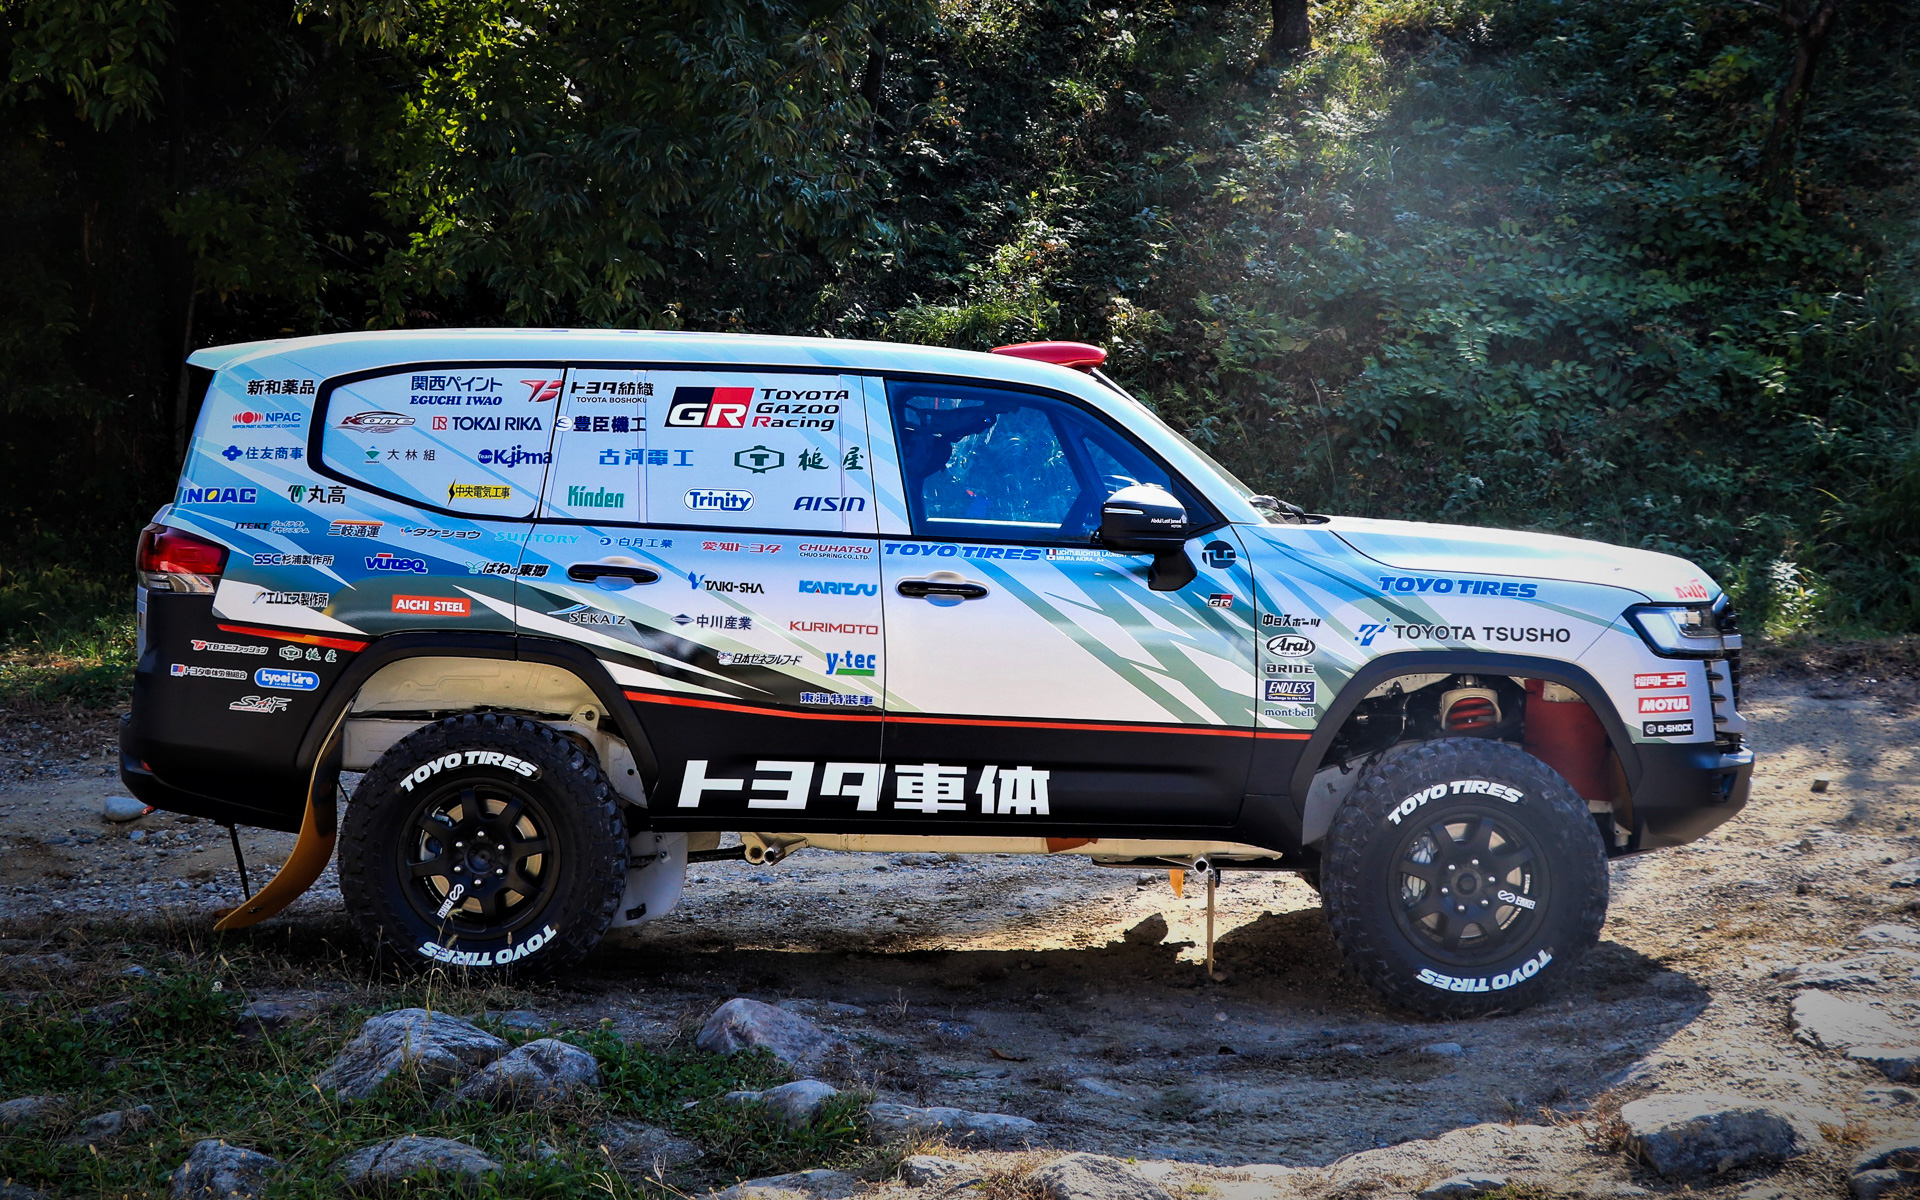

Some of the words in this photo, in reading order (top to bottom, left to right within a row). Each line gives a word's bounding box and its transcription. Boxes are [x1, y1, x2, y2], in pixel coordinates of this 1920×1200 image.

[247, 379, 316, 396] 新和薬品
[411, 376, 503, 392] 関西ペイント
[571, 381, 654, 396] トヨタ紡織
[410, 395, 461, 406] EGUCHI
[466, 396, 502, 406] IWAO
[760, 388, 849, 400] TOYOTA
[668, 403, 747, 427] GR
[755, 403, 839, 414] GAZOO
[265, 412, 302, 422] NPAC
[452, 416, 500, 431] TOKAI
[505, 416, 542, 431] RIKA
[573, 415, 647, 433] 豊臣機工
[752, 416, 835, 432] Racing
[246, 447, 304, 460] 住友商事
[387, 449, 436, 461] 大林組
[599, 448, 694, 467] 古河電工
[308, 485, 347, 504] 丸高
[455, 485, 511, 499] 中央電気工事
[568, 486, 624, 508] Kinden
[689, 491, 752, 511] Trinity
[793, 496, 865, 511] AISIN
[233, 522, 270, 530] JTEKT
[328, 524, 381, 538] 三岐通運
[413, 527, 481, 539] タケショウ
[618, 537, 673, 549] 白月工業
[702, 541, 782, 553] 愛知トヨタ
[798, 543, 873, 554] CHUHATSU
[884, 543, 960, 558] TOYO
[961, 547, 1041, 561] TIRES
[254, 555, 281, 565] SSC
[482, 562, 550, 577] ばねの東郷
[704, 580, 765, 594] TAIKI-SHA
[1378, 576, 1456, 594] TOYO
[1457, 580, 1538, 598] TIRES
[265, 592, 329, 608] エムエス製作所
[395, 599, 430, 611] AICHI
[433, 601, 466, 613] STEEL
[570, 613, 627, 625] SEKAIZ
[696, 615, 752, 630] 中川産業
[1262, 614, 1321, 627] 中日スポーツ
[789, 621, 878, 635] KURIMOTO
[1394, 624, 1476, 641] TOYOTA
[1483, 626, 1571, 643] TSUSHO
[1269, 637, 1311, 652] Arai
[732, 653, 803, 666] 日本ゼネラルフード
[1266, 664, 1315, 673] BRIDE
[262, 670, 290, 685] kyoei
[292, 673, 314, 685] tire
[1268, 682, 1312, 694] ENDLESS
[800, 692, 873, 706] 東海特装車
[1641, 697, 1688, 711] MOTUL
[1658, 724, 1692, 732] G-SHOCK
[399, 752, 463, 793] TOYO
[465, 750, 538, 777] TIRES
[677, 759, 1050, 815] トヨタ車体
[1388, 783, 1448, 825] TOYO
[1450, 780, 1524, 803] TIRES
[495, 924, 557, 965] TOYO
[418, 941, 492, 966] TIRES
[1492, 949, 1552, 991] TOYO
[1416, 968, 1490, 992] TIRES
